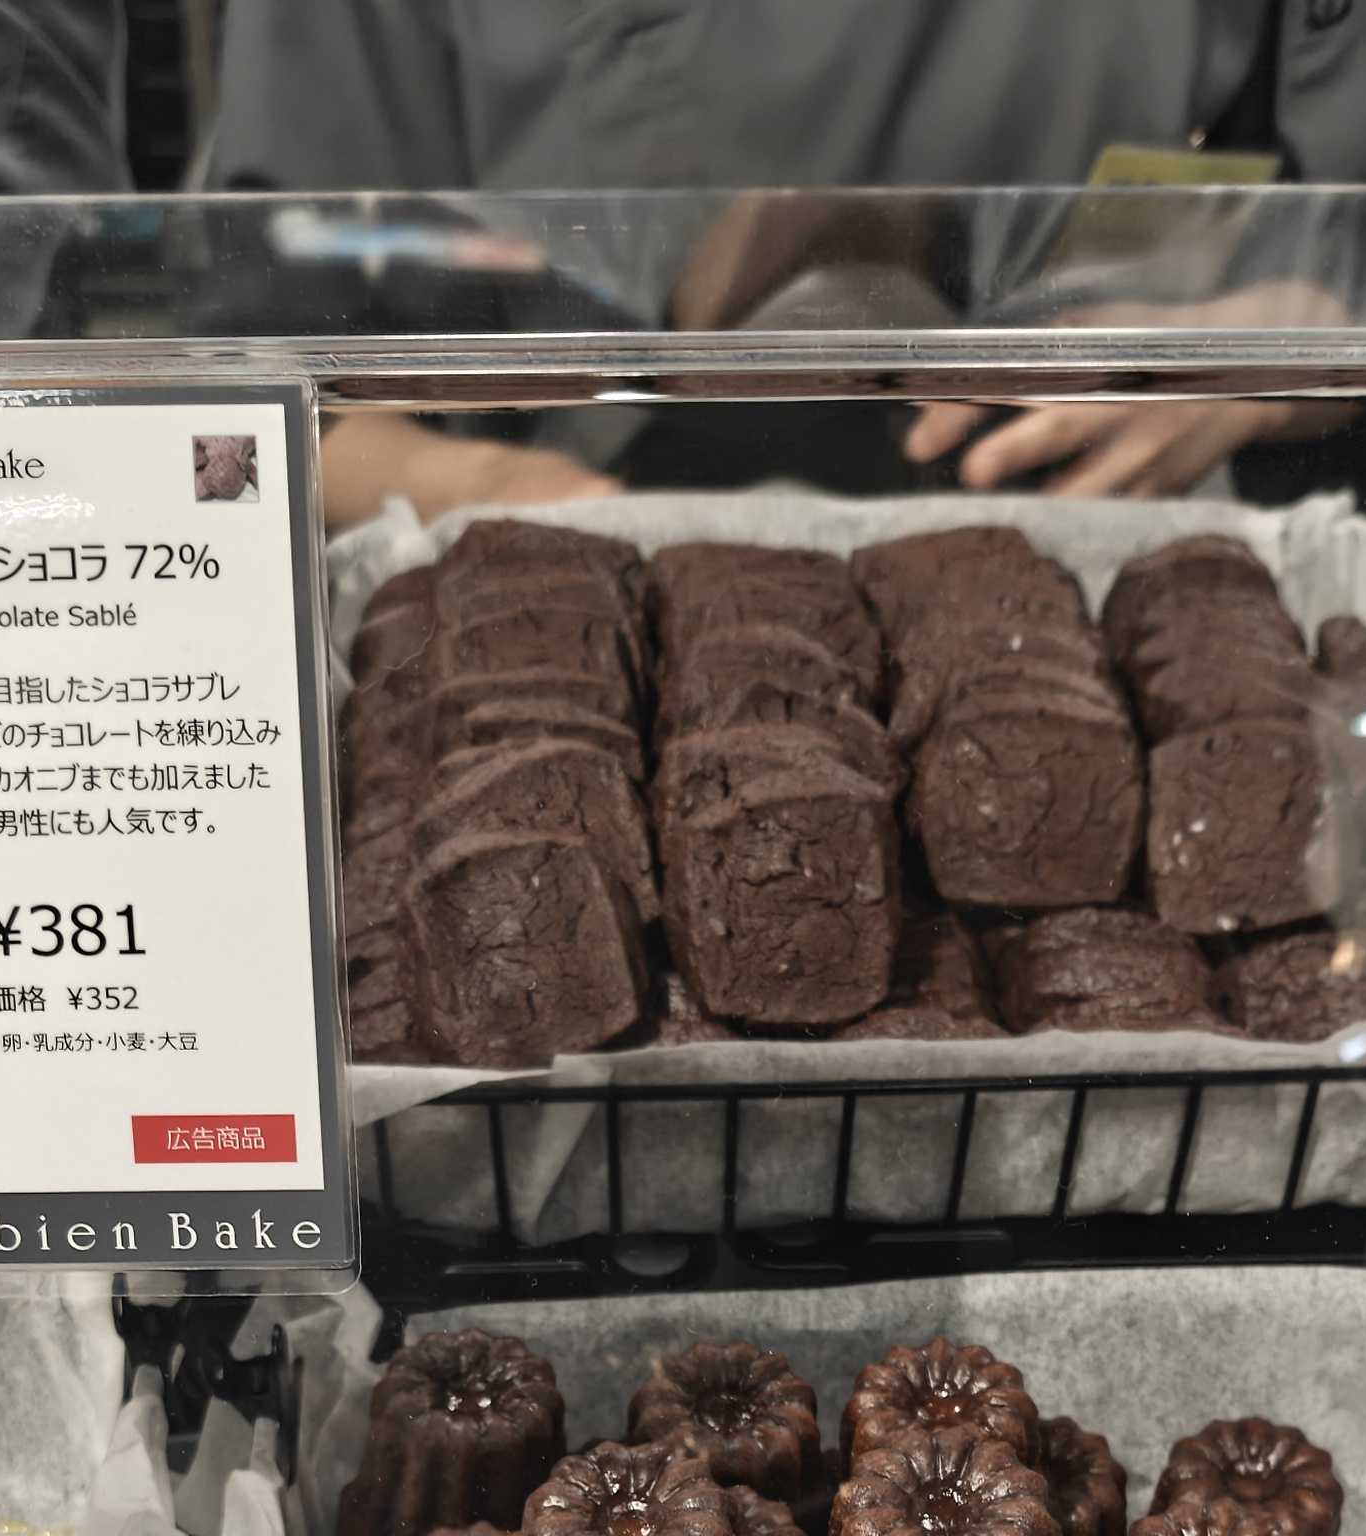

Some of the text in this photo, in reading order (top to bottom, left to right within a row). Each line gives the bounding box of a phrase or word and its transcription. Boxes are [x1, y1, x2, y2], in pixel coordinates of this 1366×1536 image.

[124, 543, 220, 580] 72%
[68, 602, 137, 627] Sablé
[66, 986, 139, 1011] ¥352
[167, 1125, 266, 1151] 広告商品
[167, 1208, 321, 1250] Bake
